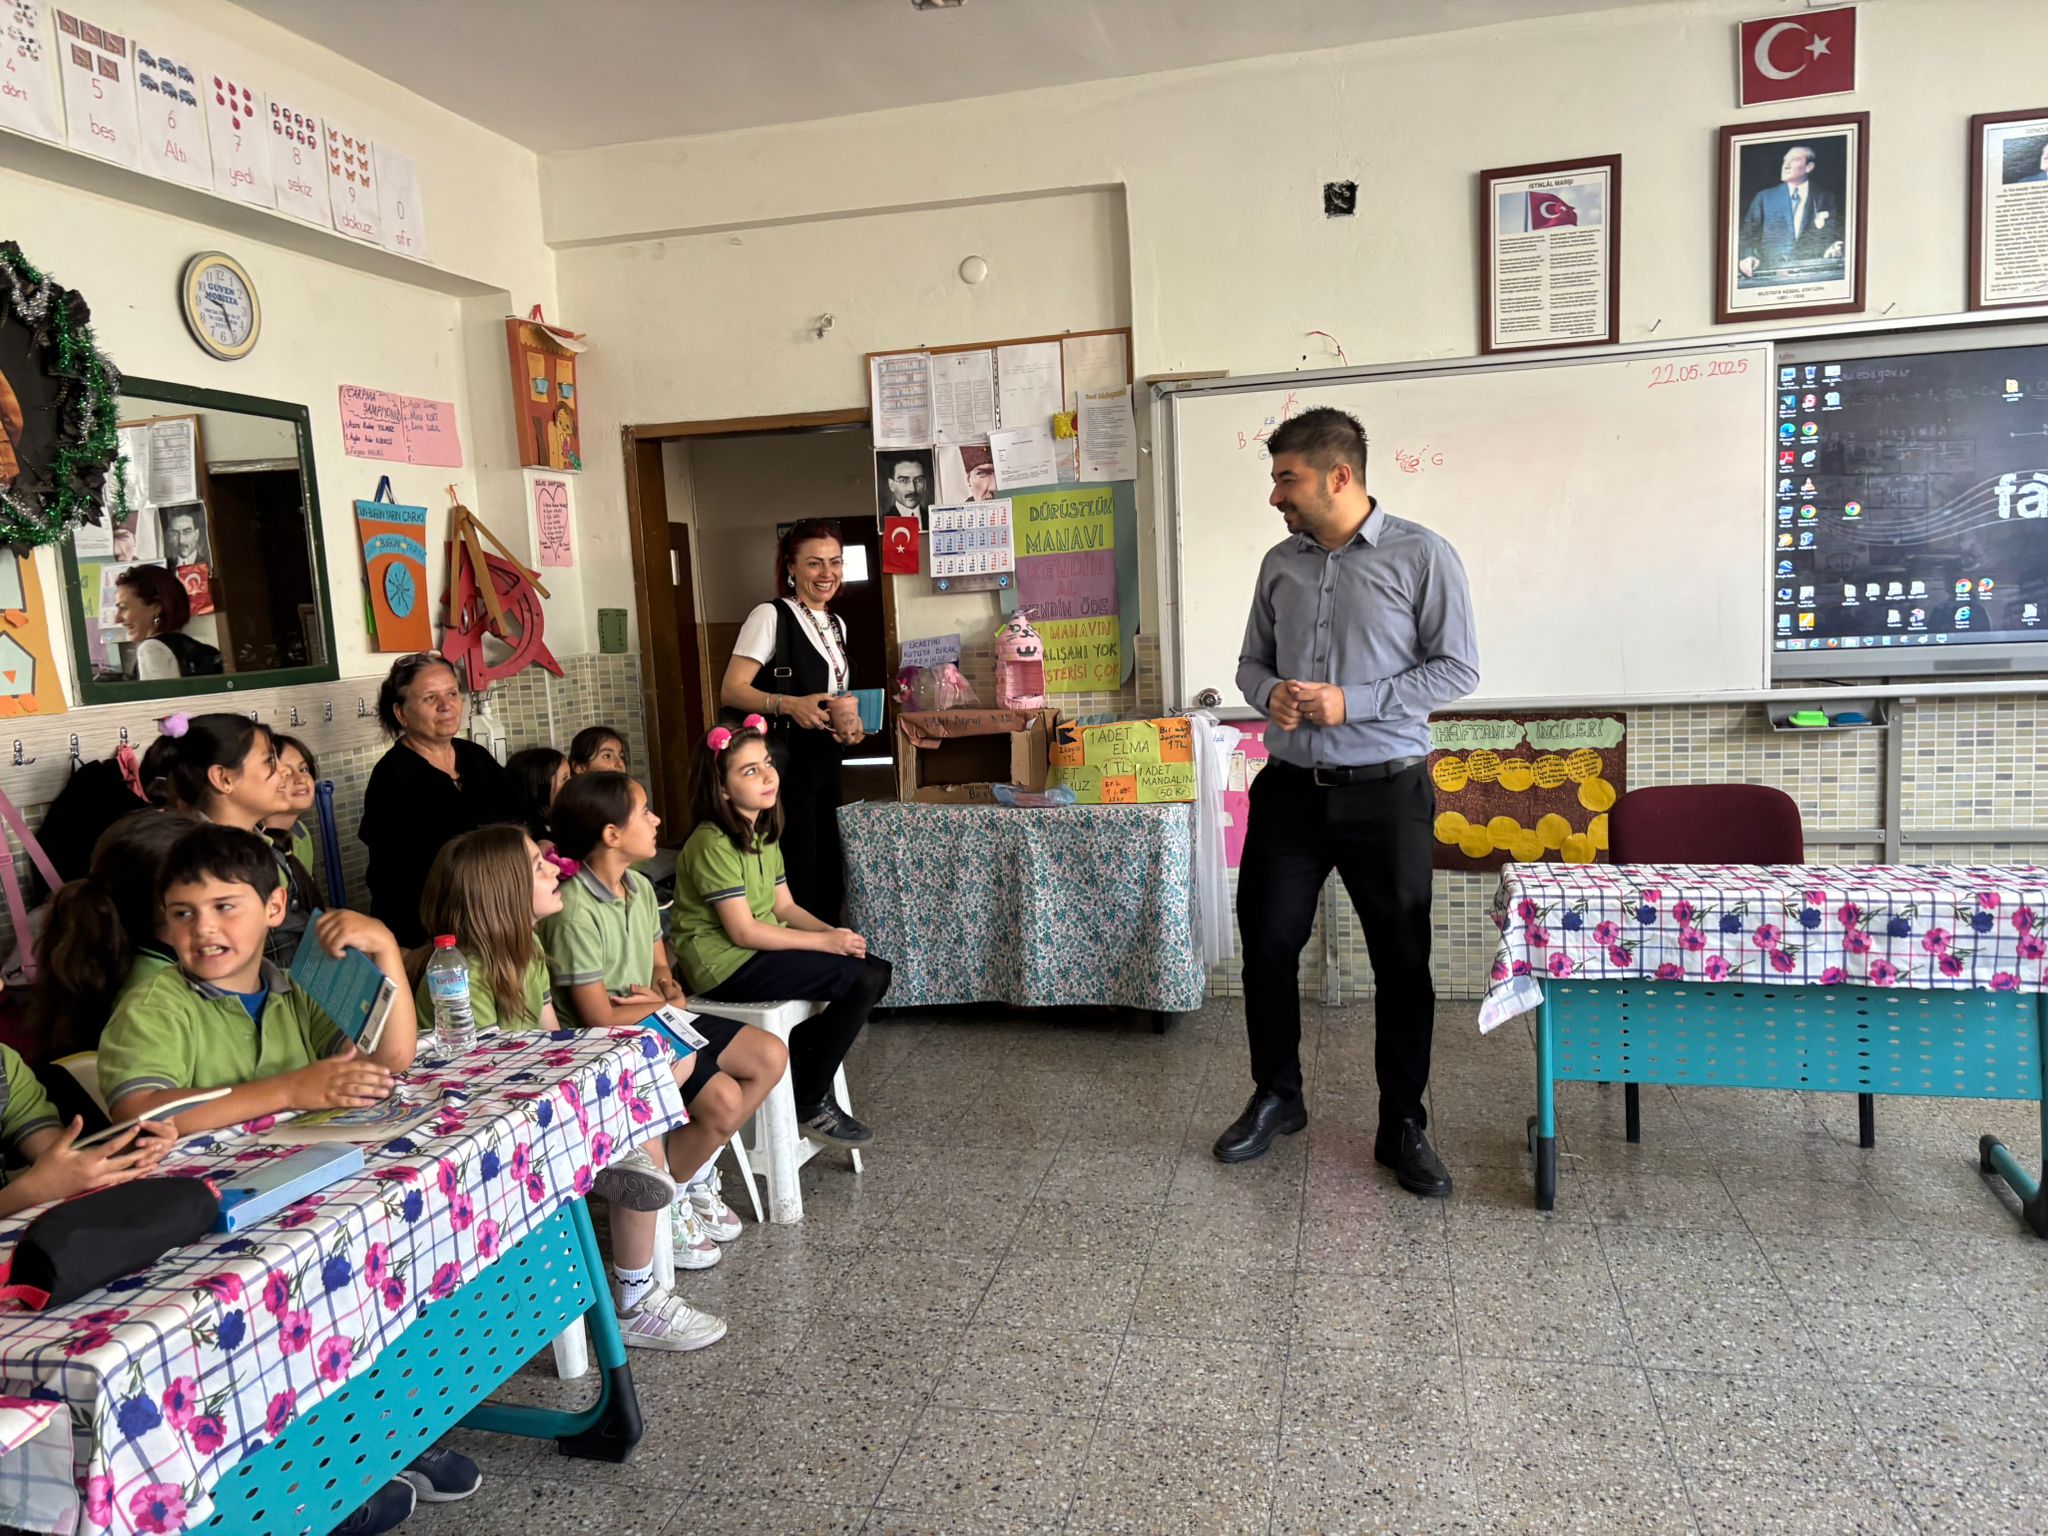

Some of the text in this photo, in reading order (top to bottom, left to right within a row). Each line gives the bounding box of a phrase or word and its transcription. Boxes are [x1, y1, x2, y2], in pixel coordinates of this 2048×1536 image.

[91, 78, 103, 99] 5
[167, 110, 176, 129] 6
[293, 147, 301, 165] 8
[1237, 431, 1247, 449] B
[1029, 496, 1113, 522] DÜRÜSTLÜK
[1025, 524, 1104, 554] MANAVI
[1027, 552, 1105, 582] KENDİN
[1080, 597, 1108, 616] ÖDE
[1049, 621, 1111, 640] MANAVIN
[1043, 643, 1118, 664] ALIŞANI YOK
[1044, 663, 1119, 685] ŞTERİSİ ÇOK
[1098, 727, 1132, 742] ADET
[1435, 720, 1603, 742] HAFTANIN İNCİLERİ
[1113, 740, 1150, 755] ELMA
[1145, 764, 1172, 776] ADET
[1160, 788, 1172, 798] 50
